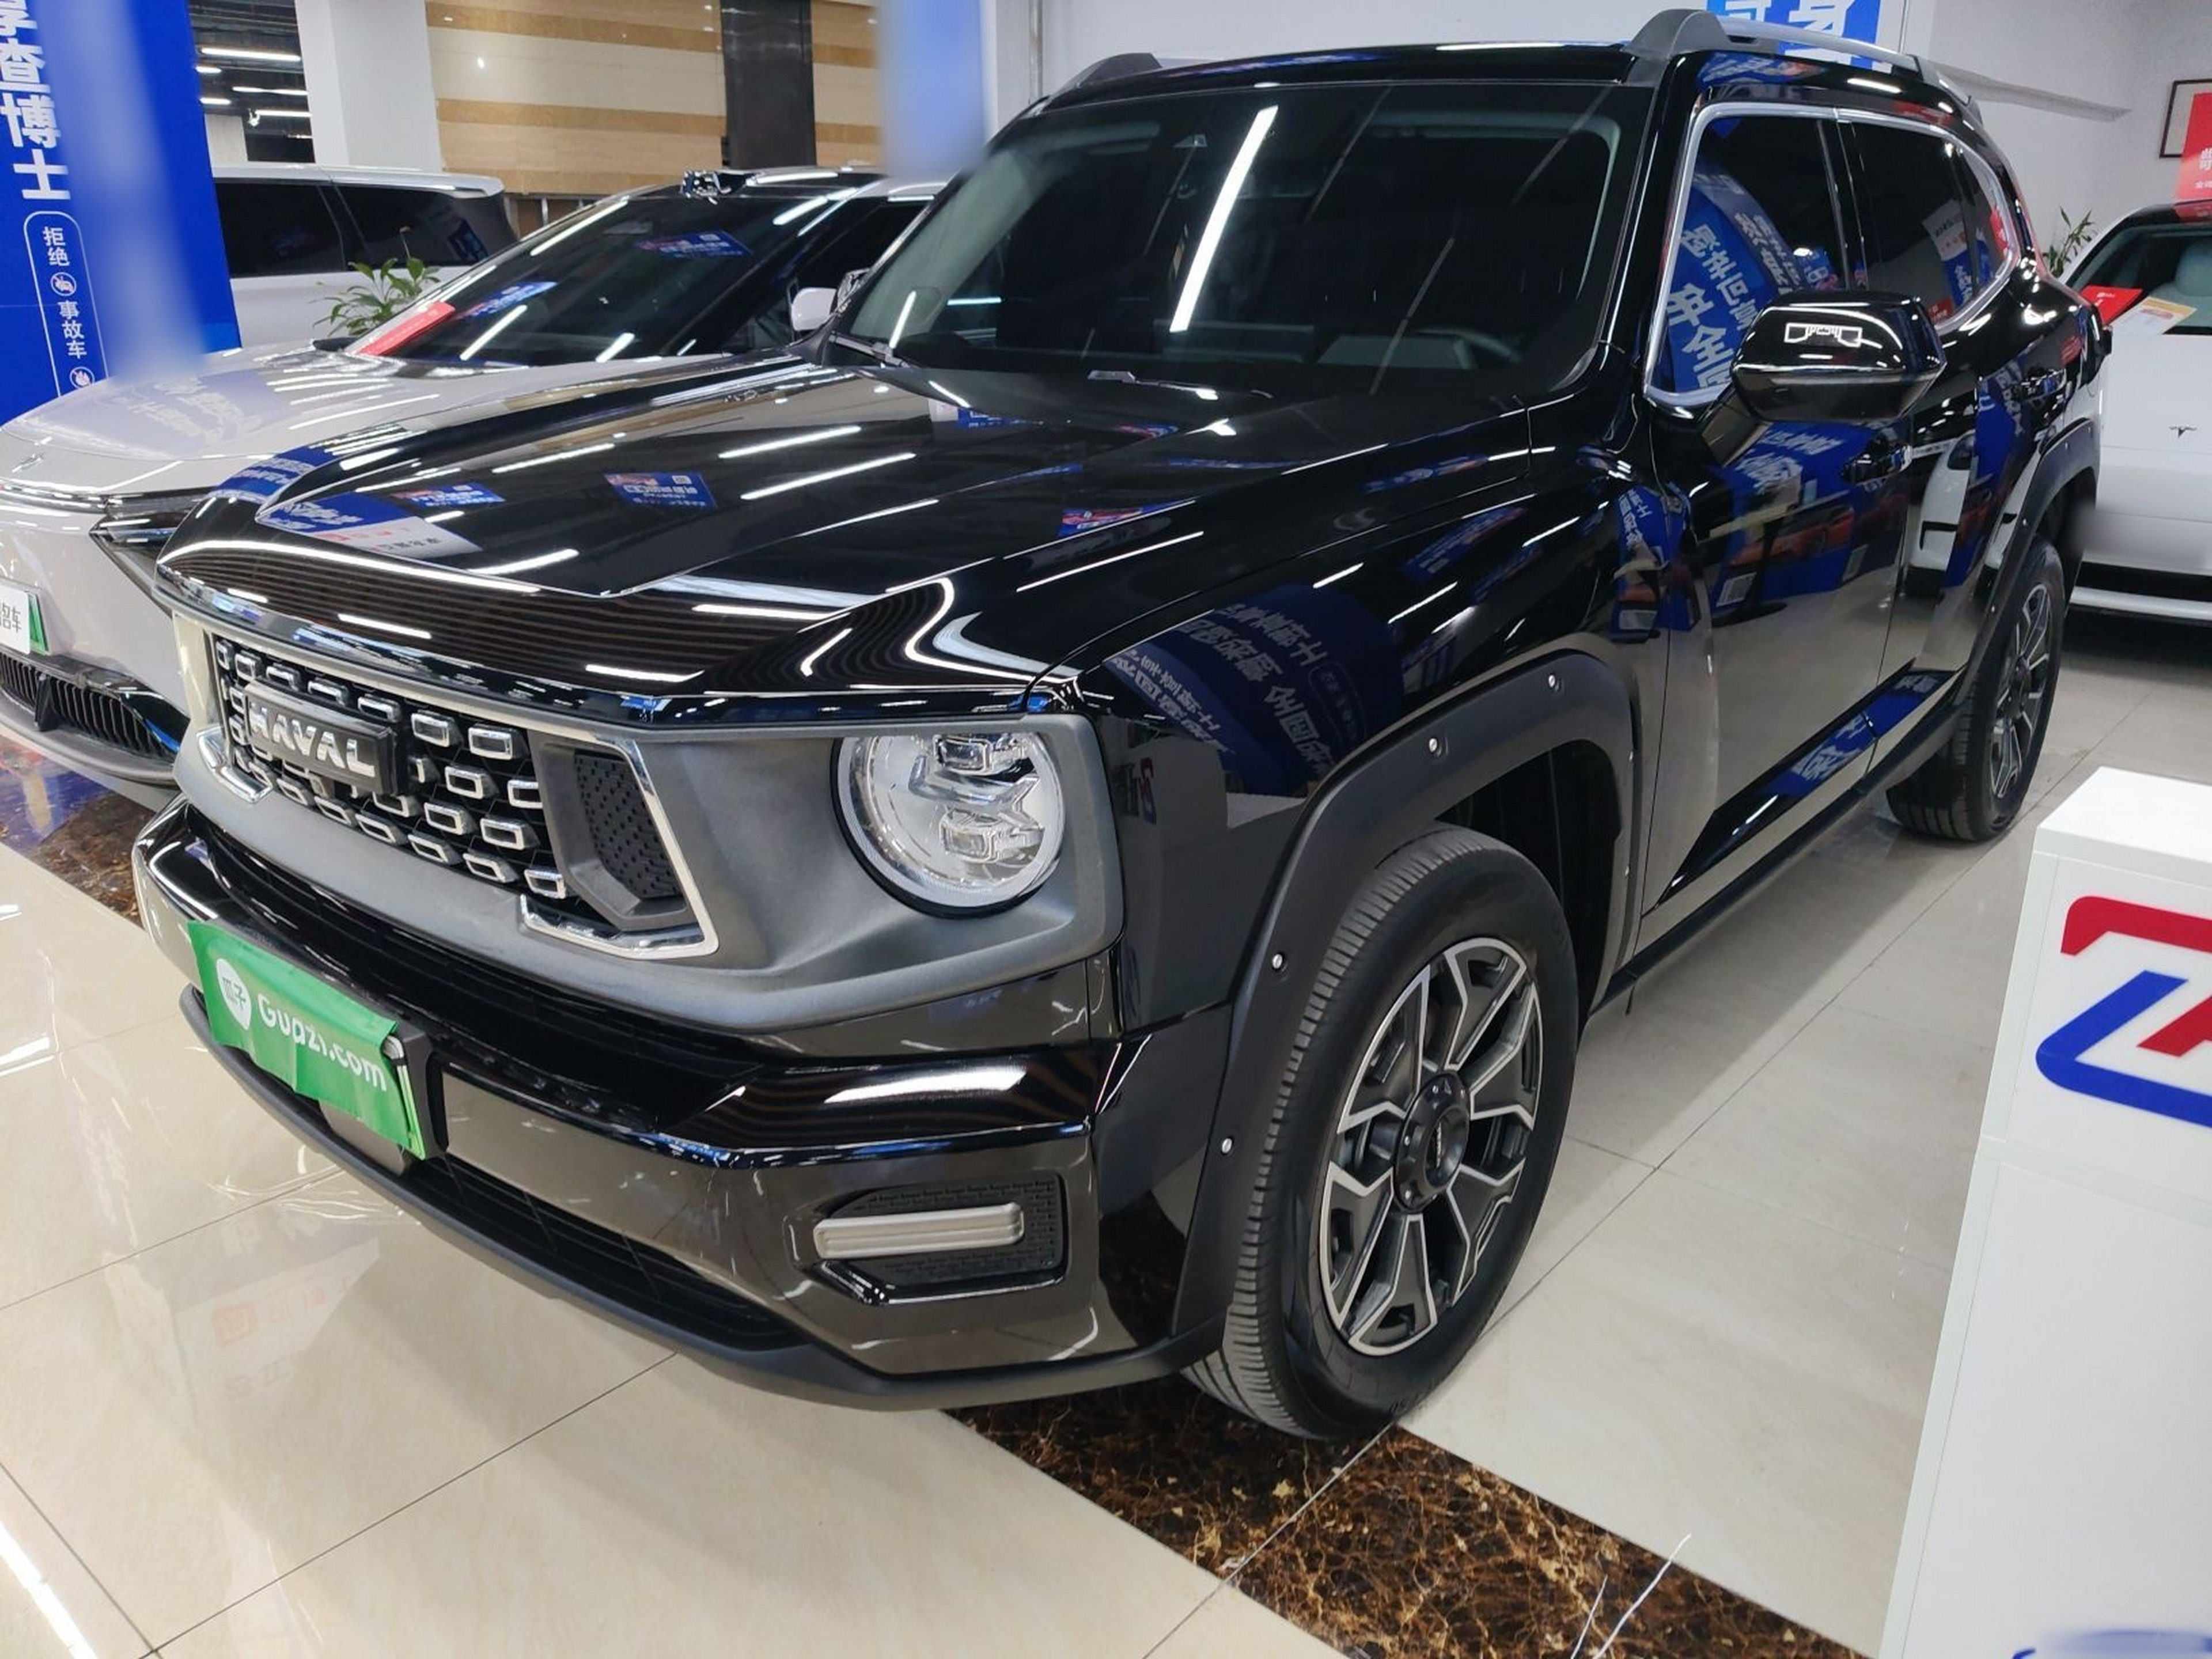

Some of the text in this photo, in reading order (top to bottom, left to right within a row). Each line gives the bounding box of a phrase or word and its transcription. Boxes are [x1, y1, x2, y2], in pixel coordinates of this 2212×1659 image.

[58, 300, 88, 361] 事故车
[248, 700, 376, 778] HAVAL
[257, 991, 388, 1093] Guazi.com
